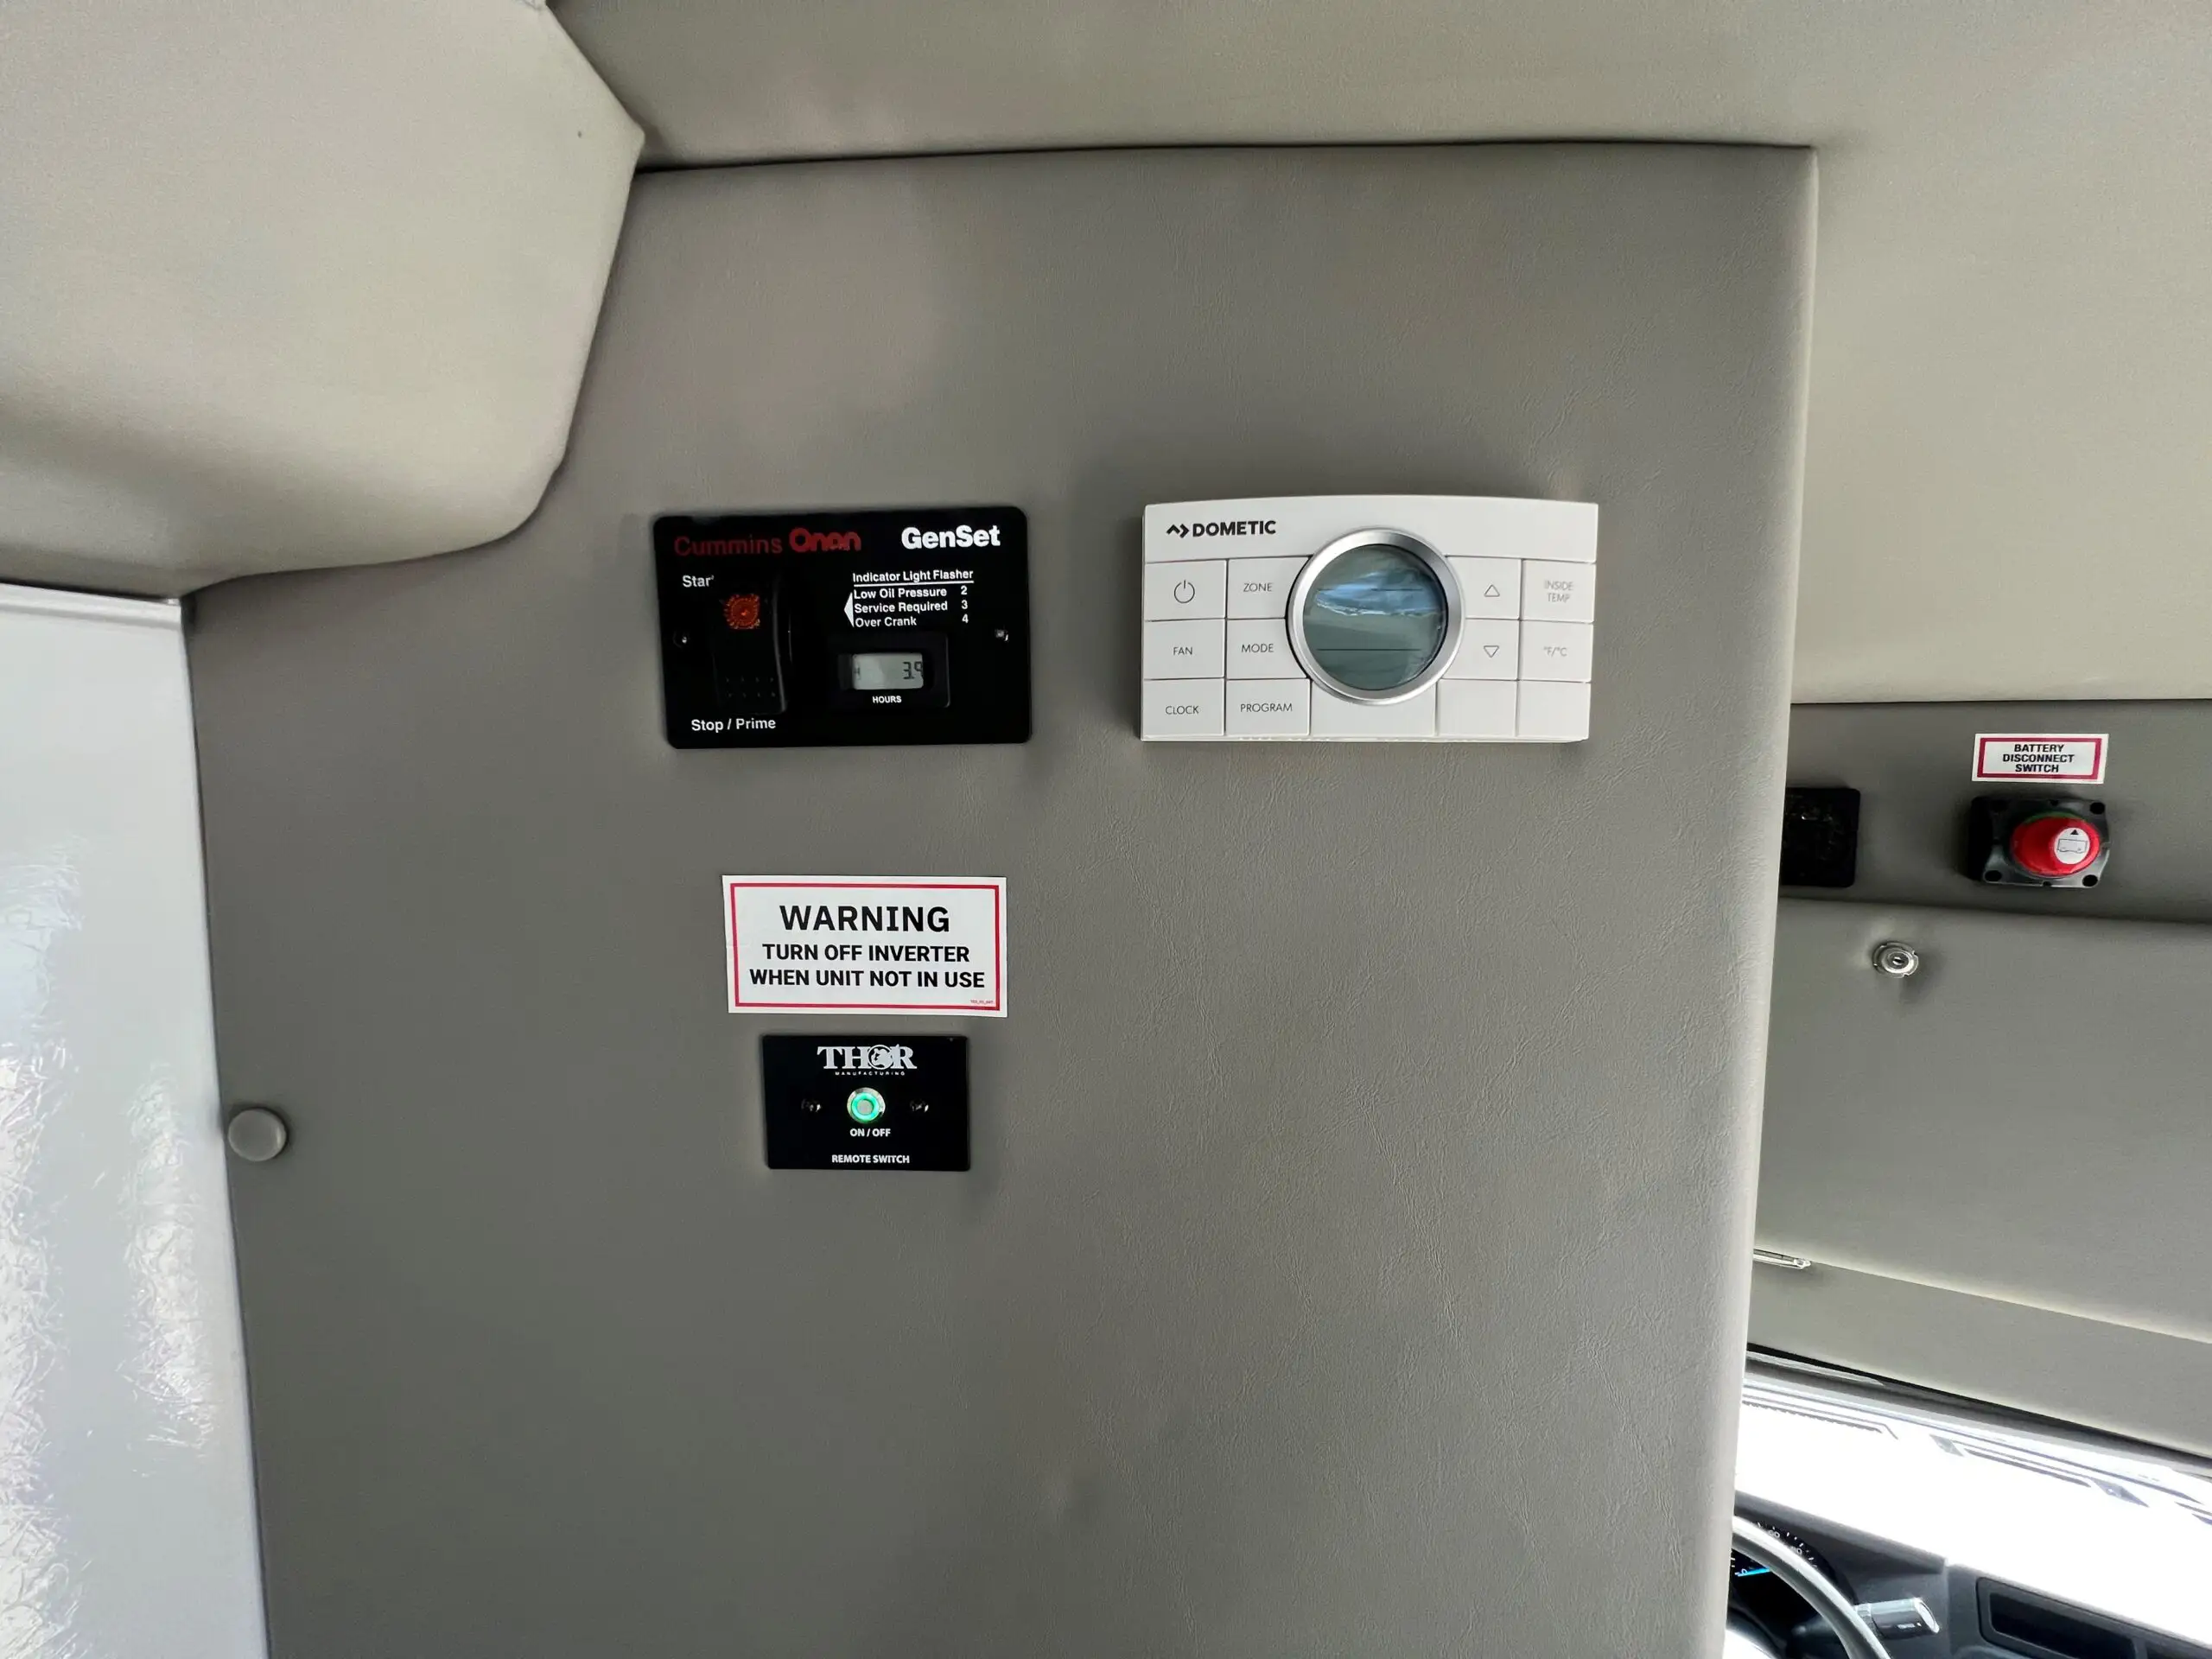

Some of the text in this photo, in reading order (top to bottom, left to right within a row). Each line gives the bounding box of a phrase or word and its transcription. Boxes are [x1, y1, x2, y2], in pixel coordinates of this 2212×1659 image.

[1192, 519, 1277, 537] DOMETIC
[673, 526, 862, 557] Cummins Onan
[900, 524, 1001, 550] GenSet
[851, 568, 975, 585] Indicator Light Flasher
[853, 584, 969, 600] Low Oil Pressure 2
[1243, 582, 1273, 593] ZONE
[1543, 579, 1576, 593] INSIDE
[1547, 591, 1573, 605] TEMP
[854, 598, 969, 615] Service Required 3
[854, 613, 970, 629] Over Crank 4
[1173, 646, 1193, 656] FAN
[1241, 643, 1274, 653] MODE
[871, 695, 903, 704] HOURS
[1165, 704, 1199, 715] CLOCK
[1240, 702, 1293, 713] PROGRAM
[690, 718, 723, 734] Stop
[735, 717, 776, 730] Prime
[2014, 744, 2064, 753] BATTERY
[2002, 753, 2075, 763] DISCONNECT
[2015, 764, 2059, 772] SWITCH
[779, 905, 950, 933] WARNING
[761, 943, 970, 963] TURN OFF INVERTER
[749, 968, 985, 988] WHEN UNIT NOT IN USE
[817, 1043, 918, 1071] THOR
[849, 1128, 866, 1137] ON
[871, 1128, 892, 1137] OFF
[831, 1154, 910, 1164] REMOTE SWITCH
